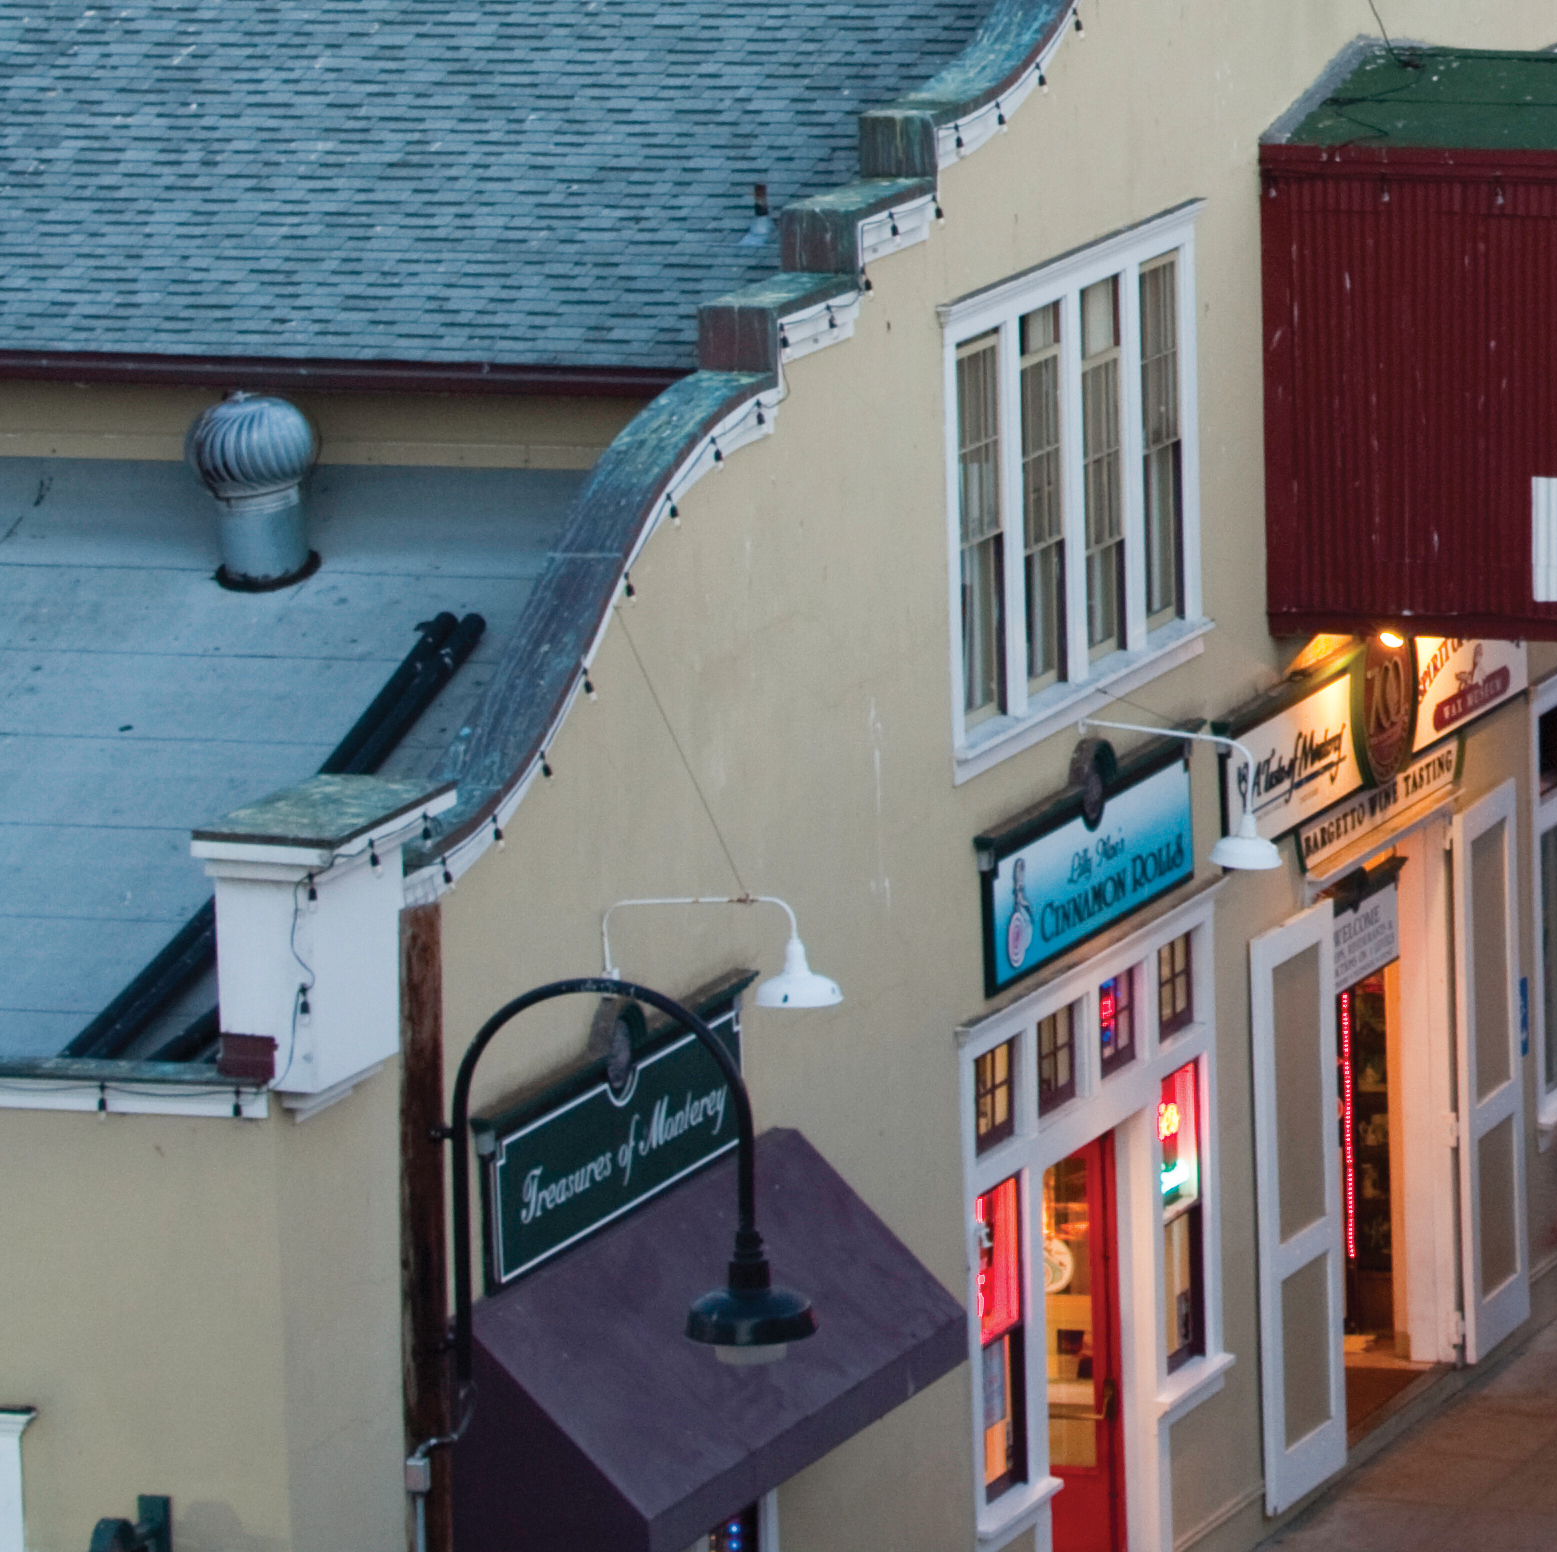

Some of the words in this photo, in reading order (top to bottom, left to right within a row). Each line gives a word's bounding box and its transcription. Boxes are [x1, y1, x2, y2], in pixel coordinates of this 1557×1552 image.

[1303, 802, 1366, 858] BARGETTO
[1403, 749, 1453, 798] TASTING
[1040, 866, 1127, 942] CINNAMON
[1131, 832, 1184, 893] ROLLS
[520, 1165, 613, 1225] Treasures
[618, 1114, 641, 1187] of
[638, 1084, 728, 1157] Monterey
